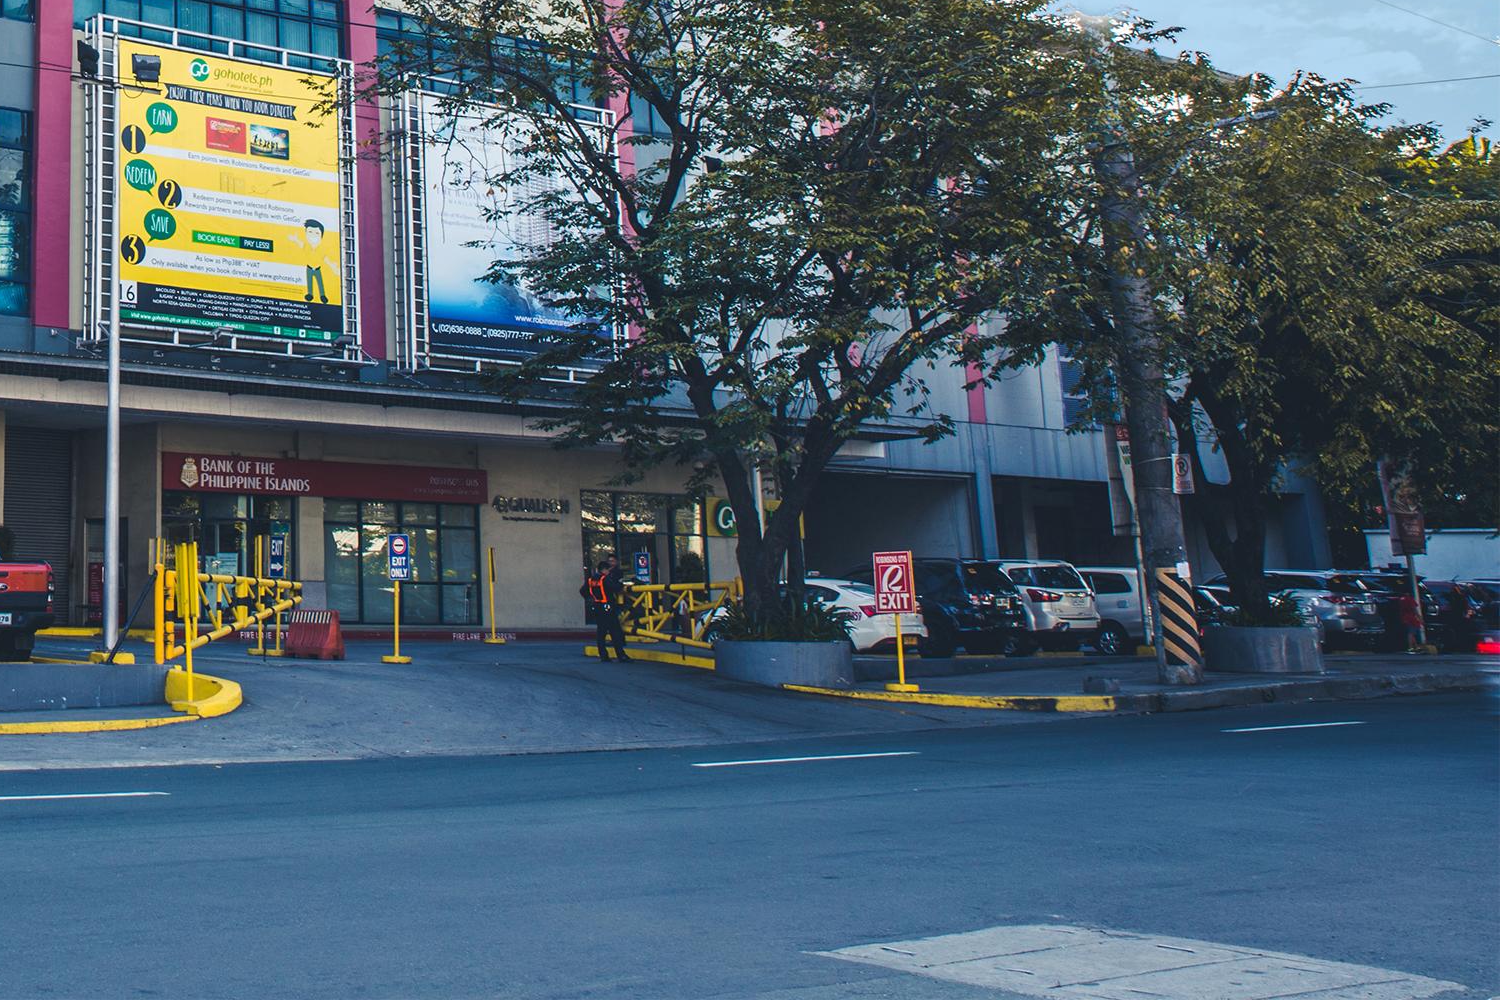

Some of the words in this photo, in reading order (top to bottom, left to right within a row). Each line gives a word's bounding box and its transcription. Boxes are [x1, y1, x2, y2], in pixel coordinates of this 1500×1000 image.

[213, 68, 273, 87] gohotels.ph
[169, 86, 187, 100] ENJOY
[189, 90, 204, 102] THESE
[241, 99, 252, 113] YOU
[152, 108, 172, 126] EARN
[126, 165, 156, 185] REDEEM
[164, 180, 176, 209] 2
[151, 214, 169, 233] SAVE
[198, 233, 216, 242] BOOK
[243, 239, 254, 247] PAY
[255, 241, 270, 250] LESS!
[128, 234, 139, 264] 3
[151, 258, 165, 268] Only
[237, 460, 252, 474] OF
[271, 540, 283, 556] EXIT
[392, 556, 406, 566] EXIT
[390, 568, 408, 579] ONLY
[878, 593, 910, 609] EXIT
